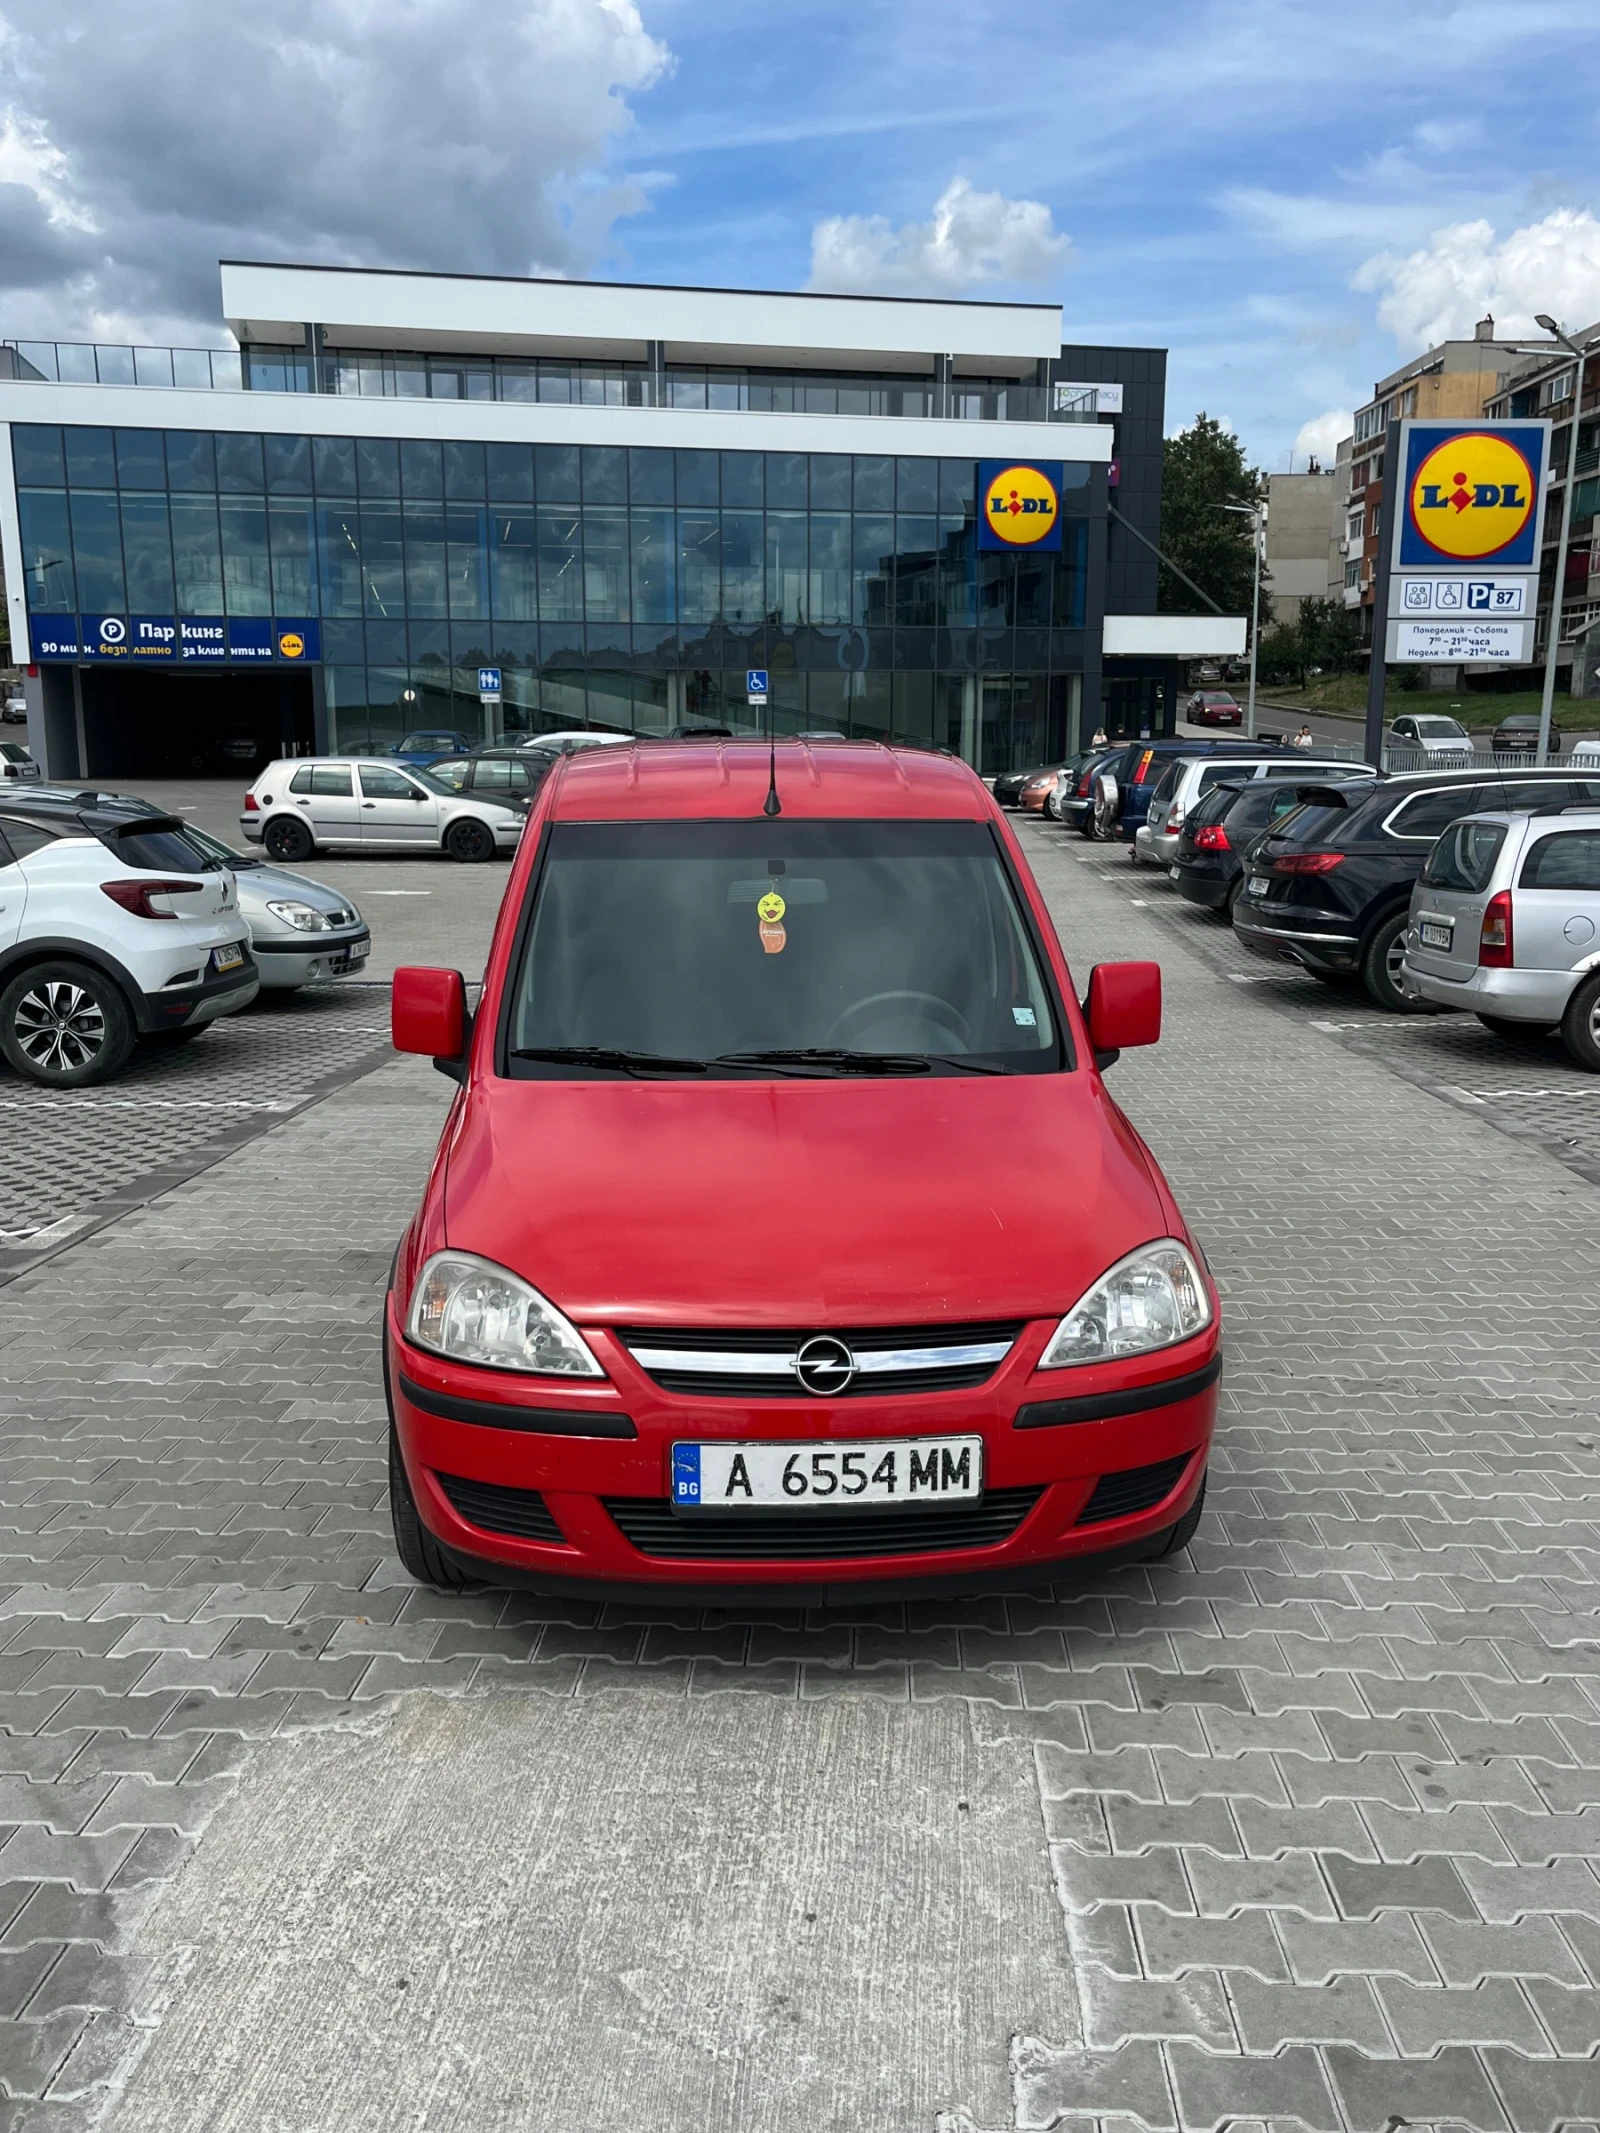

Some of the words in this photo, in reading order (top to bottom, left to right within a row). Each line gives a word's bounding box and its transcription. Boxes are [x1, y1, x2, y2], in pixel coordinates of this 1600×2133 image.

[1496, 592, 1514, 604] 87
[1413, 626, 1465, 635] Понеделник
[1474, 626, 1508, 634] Събота
[1469, 638, 1490, 646] часа
[41, 642, 57, 653] 90
[183, 647, 195, 657] за
[258, 647, 272, 656] на
[1408, 648, 1439, 658] Неделя
[1488, 649, 1509, 657] часа
[725, 1453, 752, 1497] A
[782, 1450, 898, 1497] 6554
[909, 1446, 971, 1492] MM
[678, 1482, 699, 1495] BG
